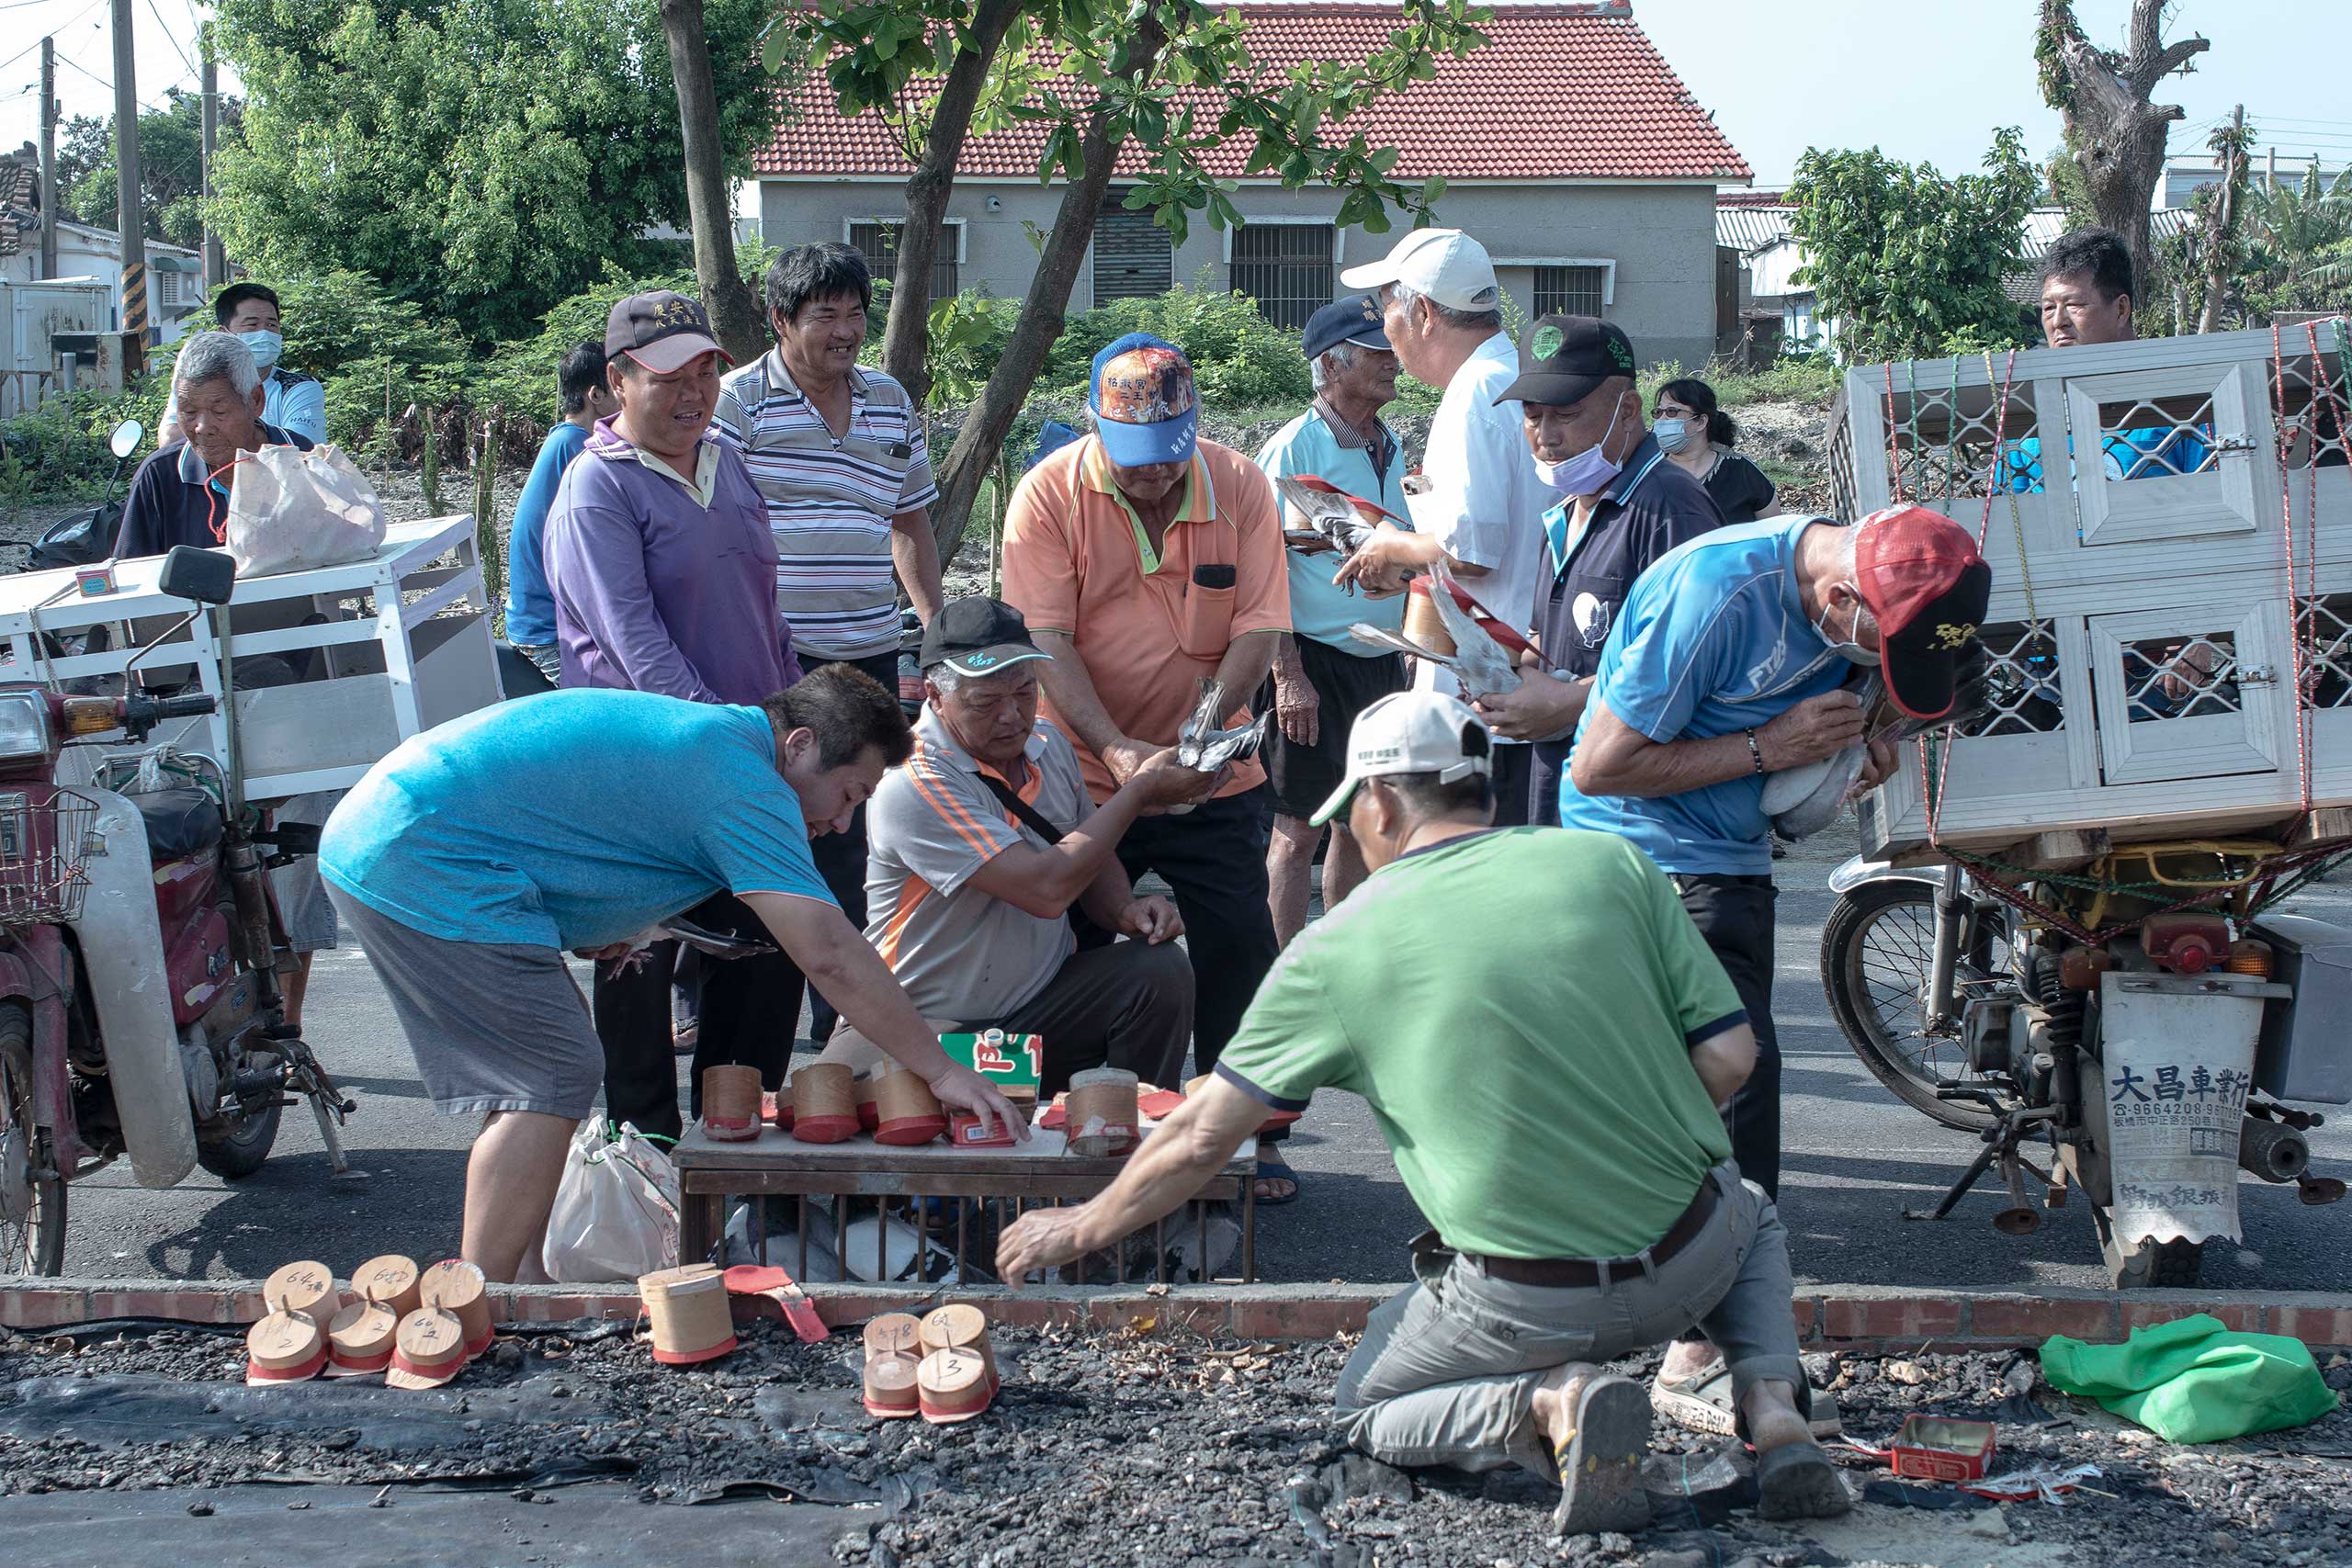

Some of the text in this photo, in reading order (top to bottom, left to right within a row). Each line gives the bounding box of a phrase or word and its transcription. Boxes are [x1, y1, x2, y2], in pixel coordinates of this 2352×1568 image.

[2110, 1065, 2249, 1108] 大昌車業行
[941, 1359, 963, 1379] 3
